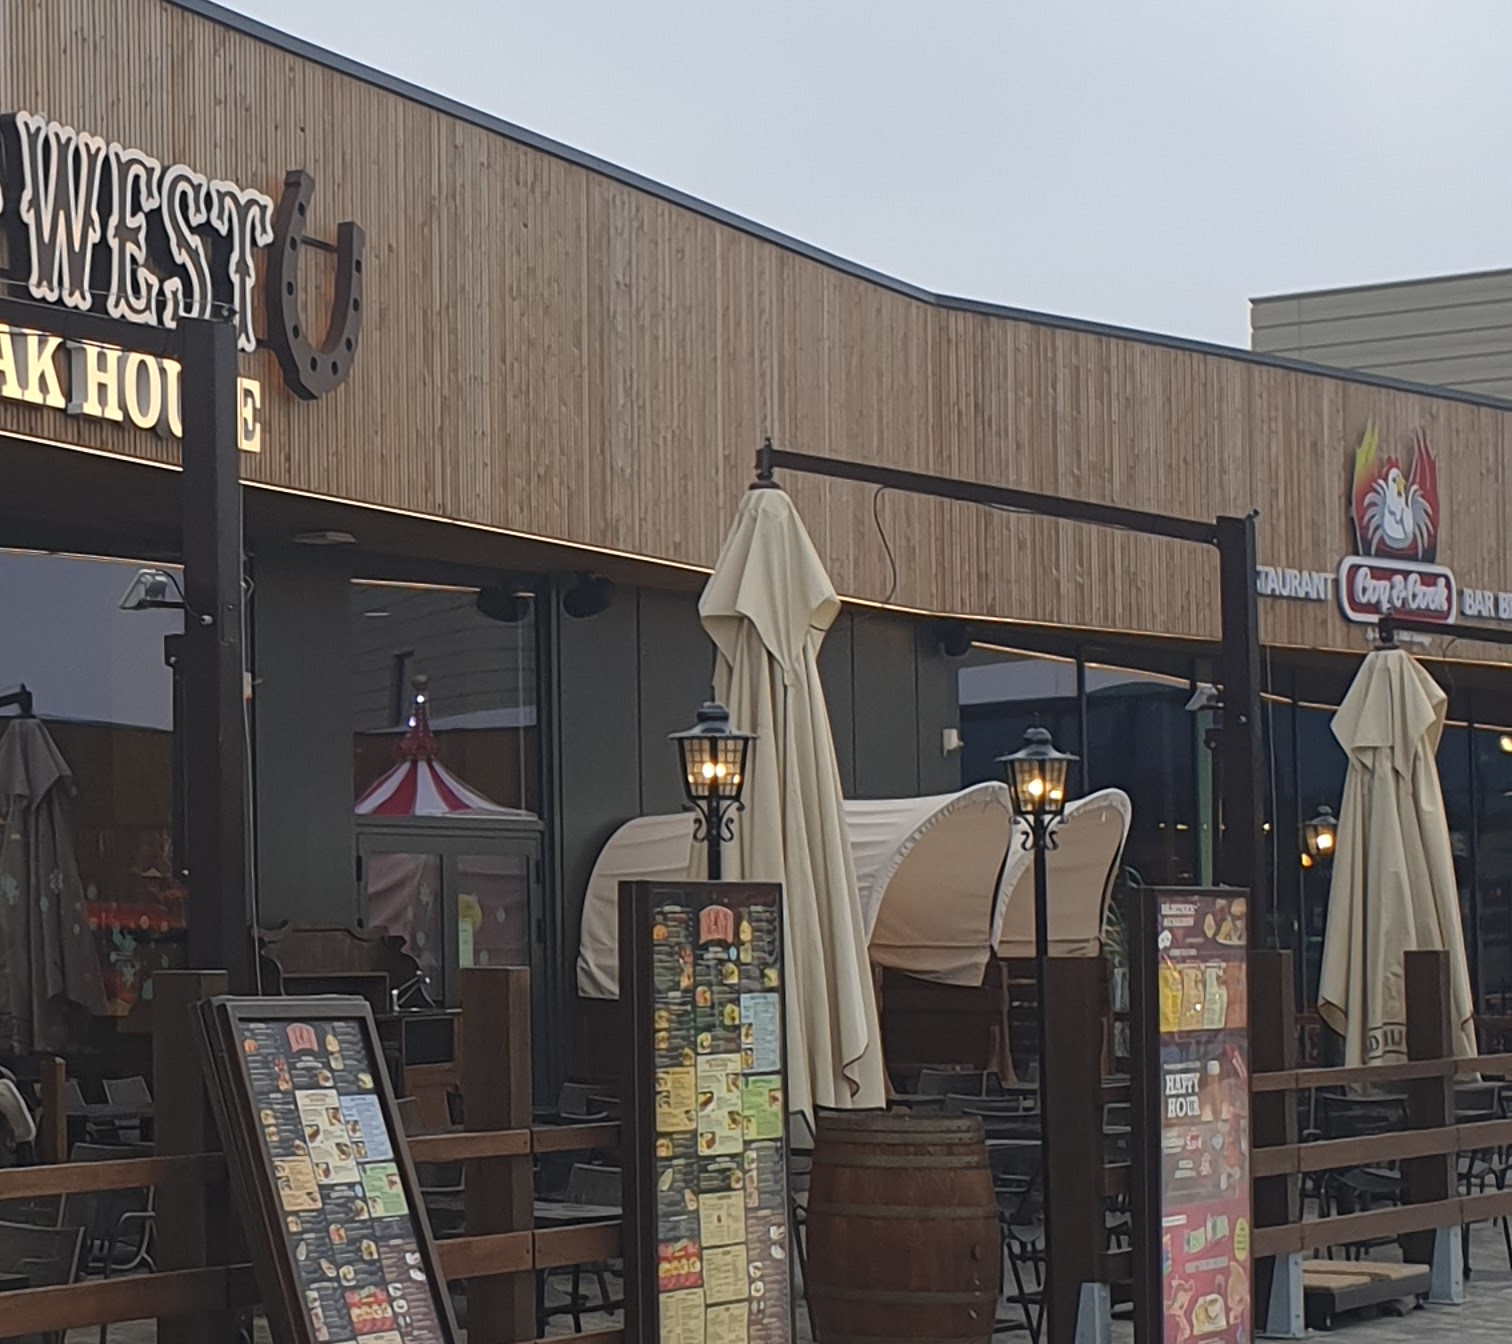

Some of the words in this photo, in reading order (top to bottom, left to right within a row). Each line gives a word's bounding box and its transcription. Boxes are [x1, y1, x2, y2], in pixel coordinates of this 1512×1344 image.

[15, 110, 275, 354] WEST
[84, 342, 261, 454] HOUE
[1256, 564, 1337, 601] TAURANT
[1462, 587, 1495, 618] BAR
[1165, 1072, 1201, 1096] HAPPY
[1167, 1096, 1201, 1118] HOUR
